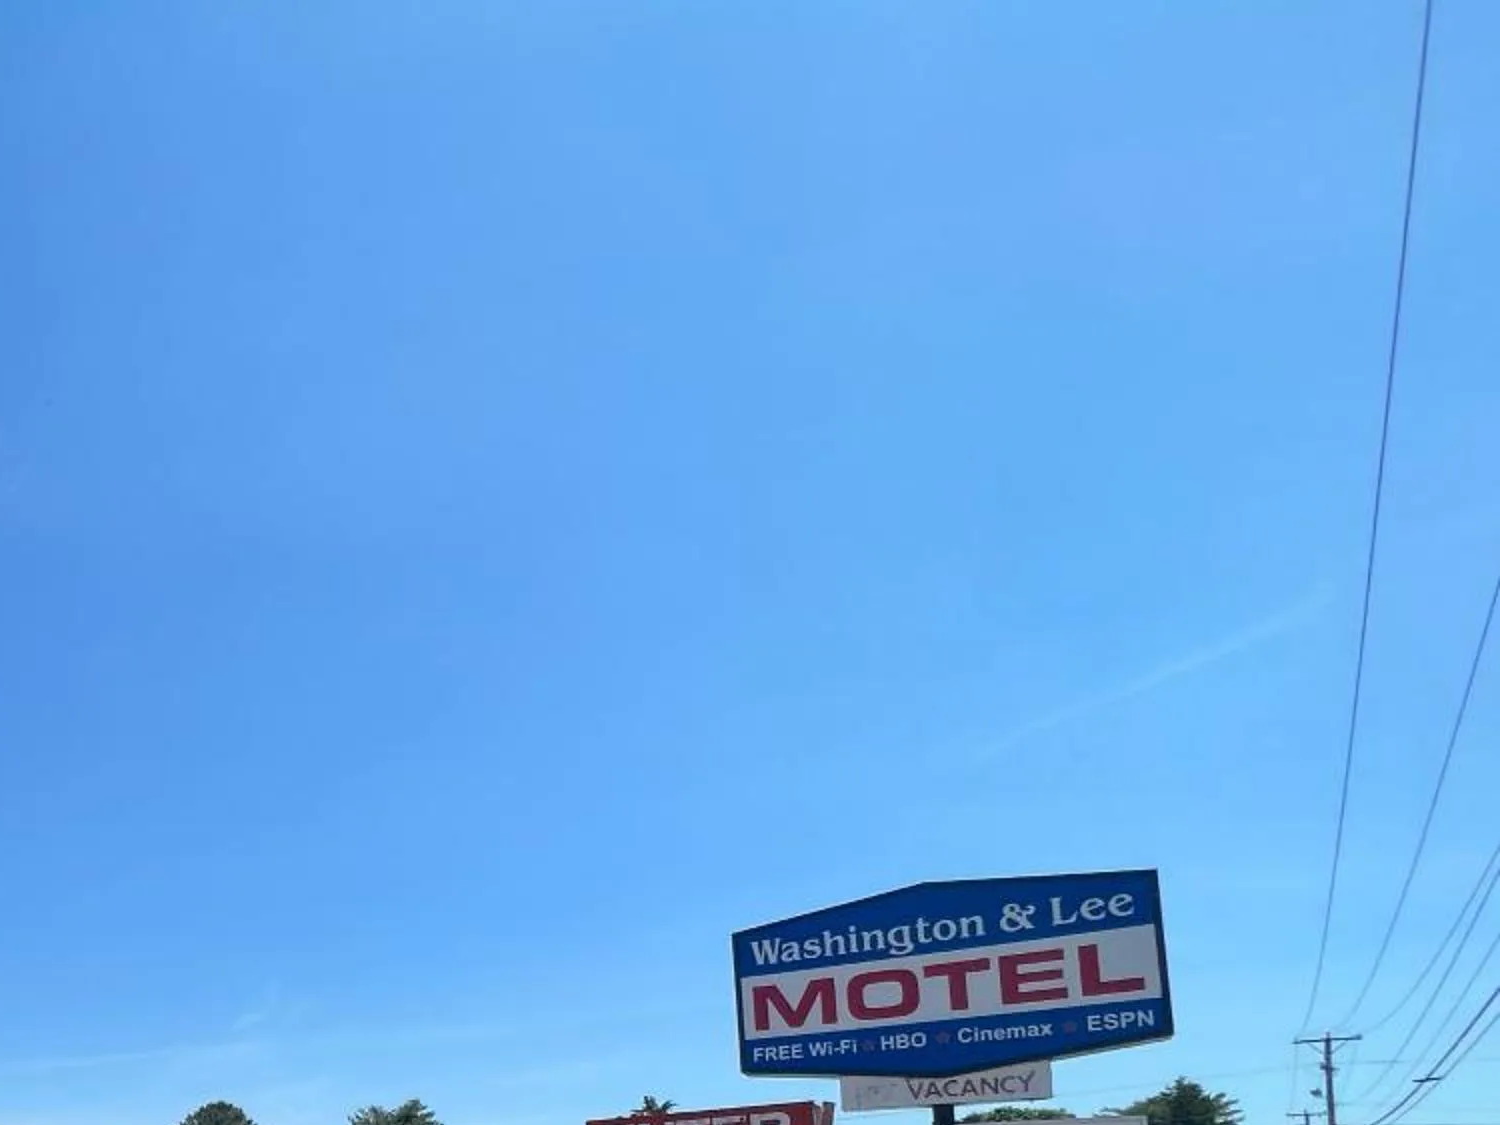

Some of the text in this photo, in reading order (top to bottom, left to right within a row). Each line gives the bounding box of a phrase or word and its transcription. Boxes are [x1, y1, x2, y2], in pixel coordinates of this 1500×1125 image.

[751, 893, 1136, 966] Washington & Lee
[752, 943, 1146, 1031] MOTEL
[753, 1009, 1154, 1062] FREE Wi-Fi HBO Cinemax ESPN
[905, 1070, 1036, 1100] VACANCY
